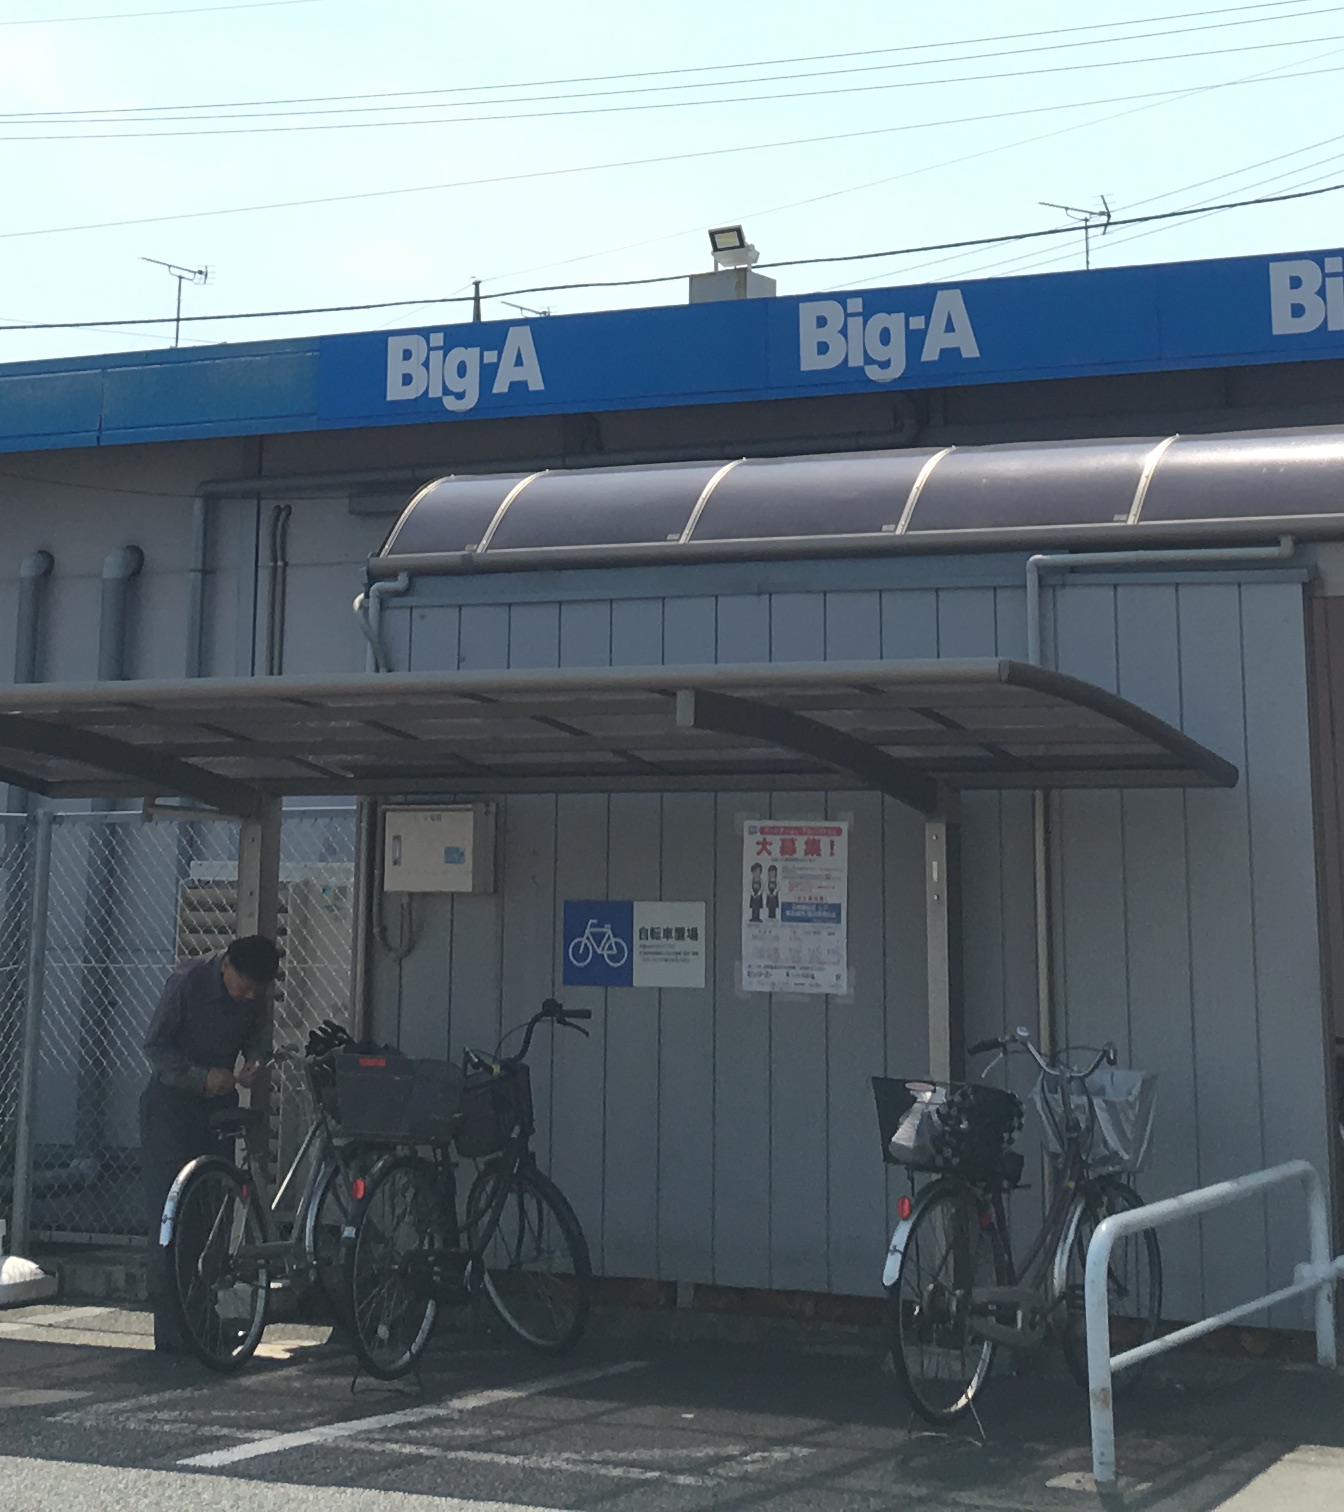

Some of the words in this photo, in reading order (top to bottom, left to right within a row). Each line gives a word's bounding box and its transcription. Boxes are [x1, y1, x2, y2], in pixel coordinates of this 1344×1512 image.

[386, 325, 545, 412] Big-A
[799, 288, 981, 382] Big-A
[638, 926, 699, 941] 自転車置場
